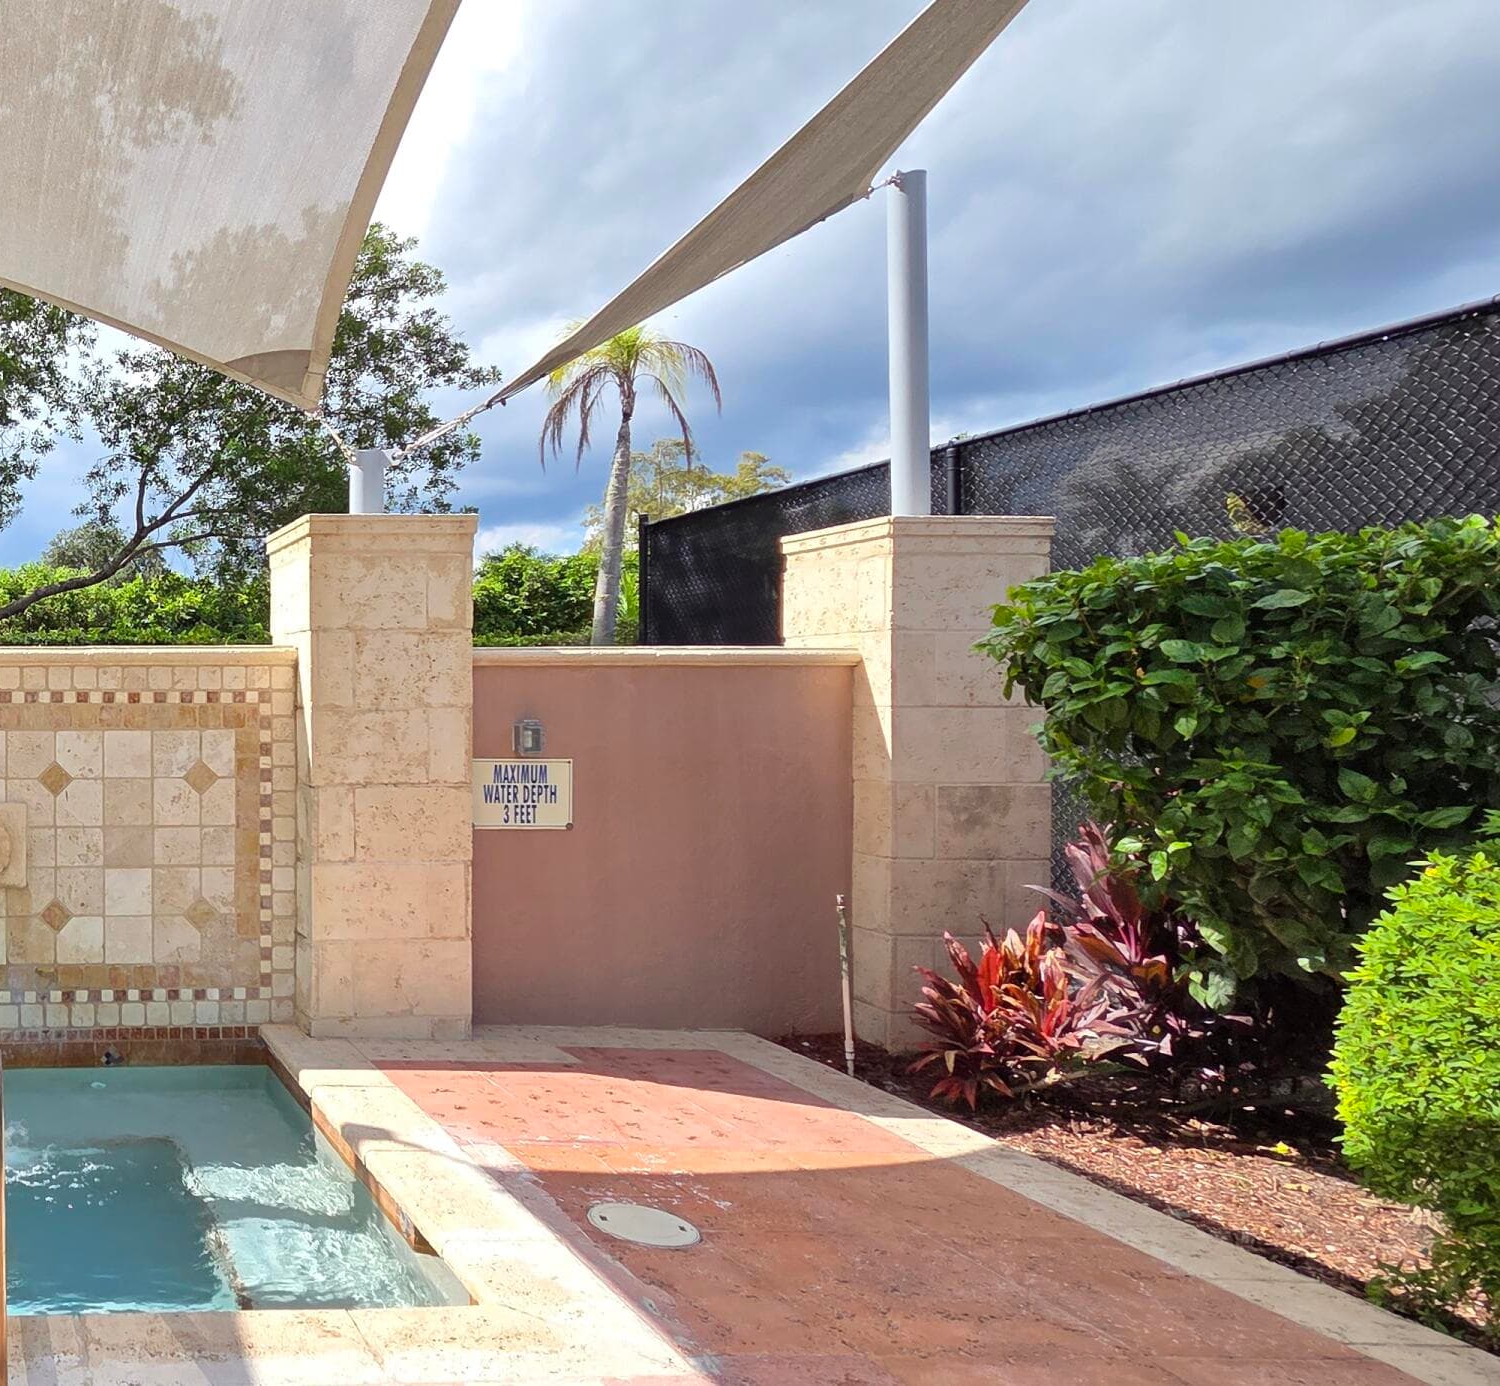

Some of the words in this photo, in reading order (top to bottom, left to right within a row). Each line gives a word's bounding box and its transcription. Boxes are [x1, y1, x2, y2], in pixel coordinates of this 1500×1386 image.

[493, 765, 547, 783] MAXIMUM
[483, 785, 519, 803] WATER
[523, 785, 557, 803] DEPTH
[503, 804, 510, 824] 3
[514, 804, 537, 824] FEET
